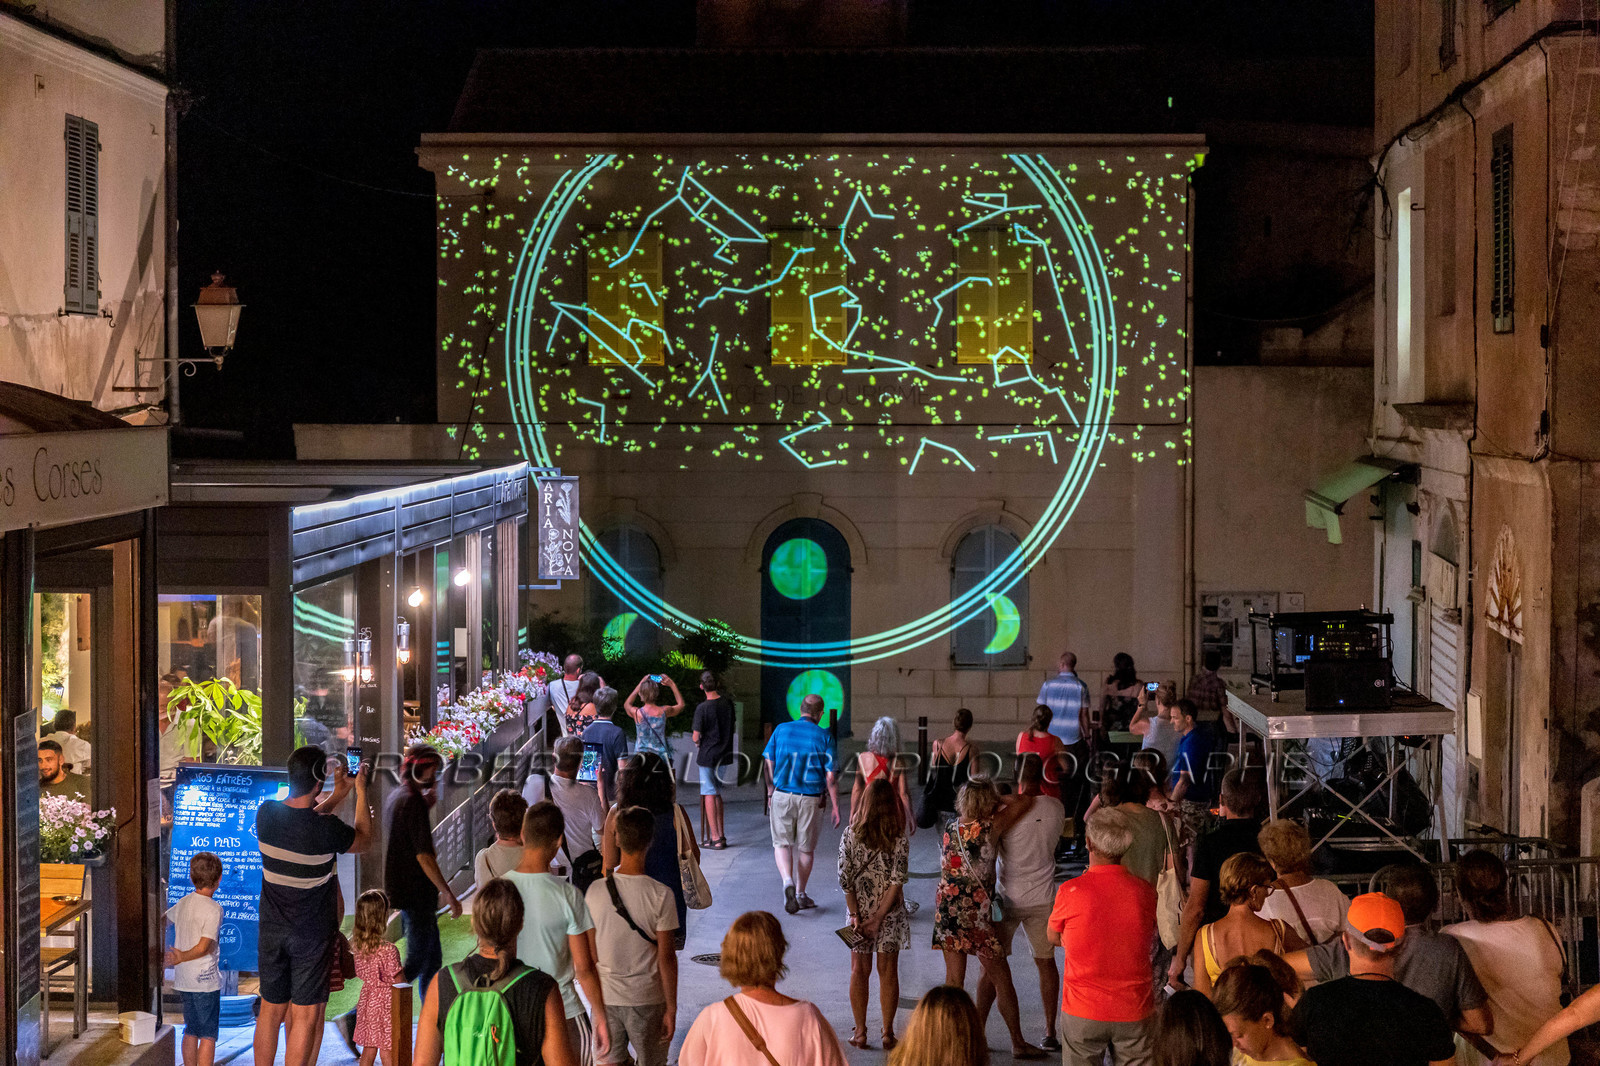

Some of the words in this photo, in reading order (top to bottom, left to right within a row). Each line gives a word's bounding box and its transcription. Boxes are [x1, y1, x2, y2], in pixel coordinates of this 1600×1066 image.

[685, 384, 768, 405] OICE
[775, 384, 805, 406] DE
[0, 466, 15, 507] s
[33, 447, 102, 502] Corses
[543, 482, 554, 529] ARIA
[562, 529, 574, 576] NOVA
[195, 773, 212, 783] NOS
[190, 836, 209, 847] NOS
[214, 837, 241, 848] PLATS
